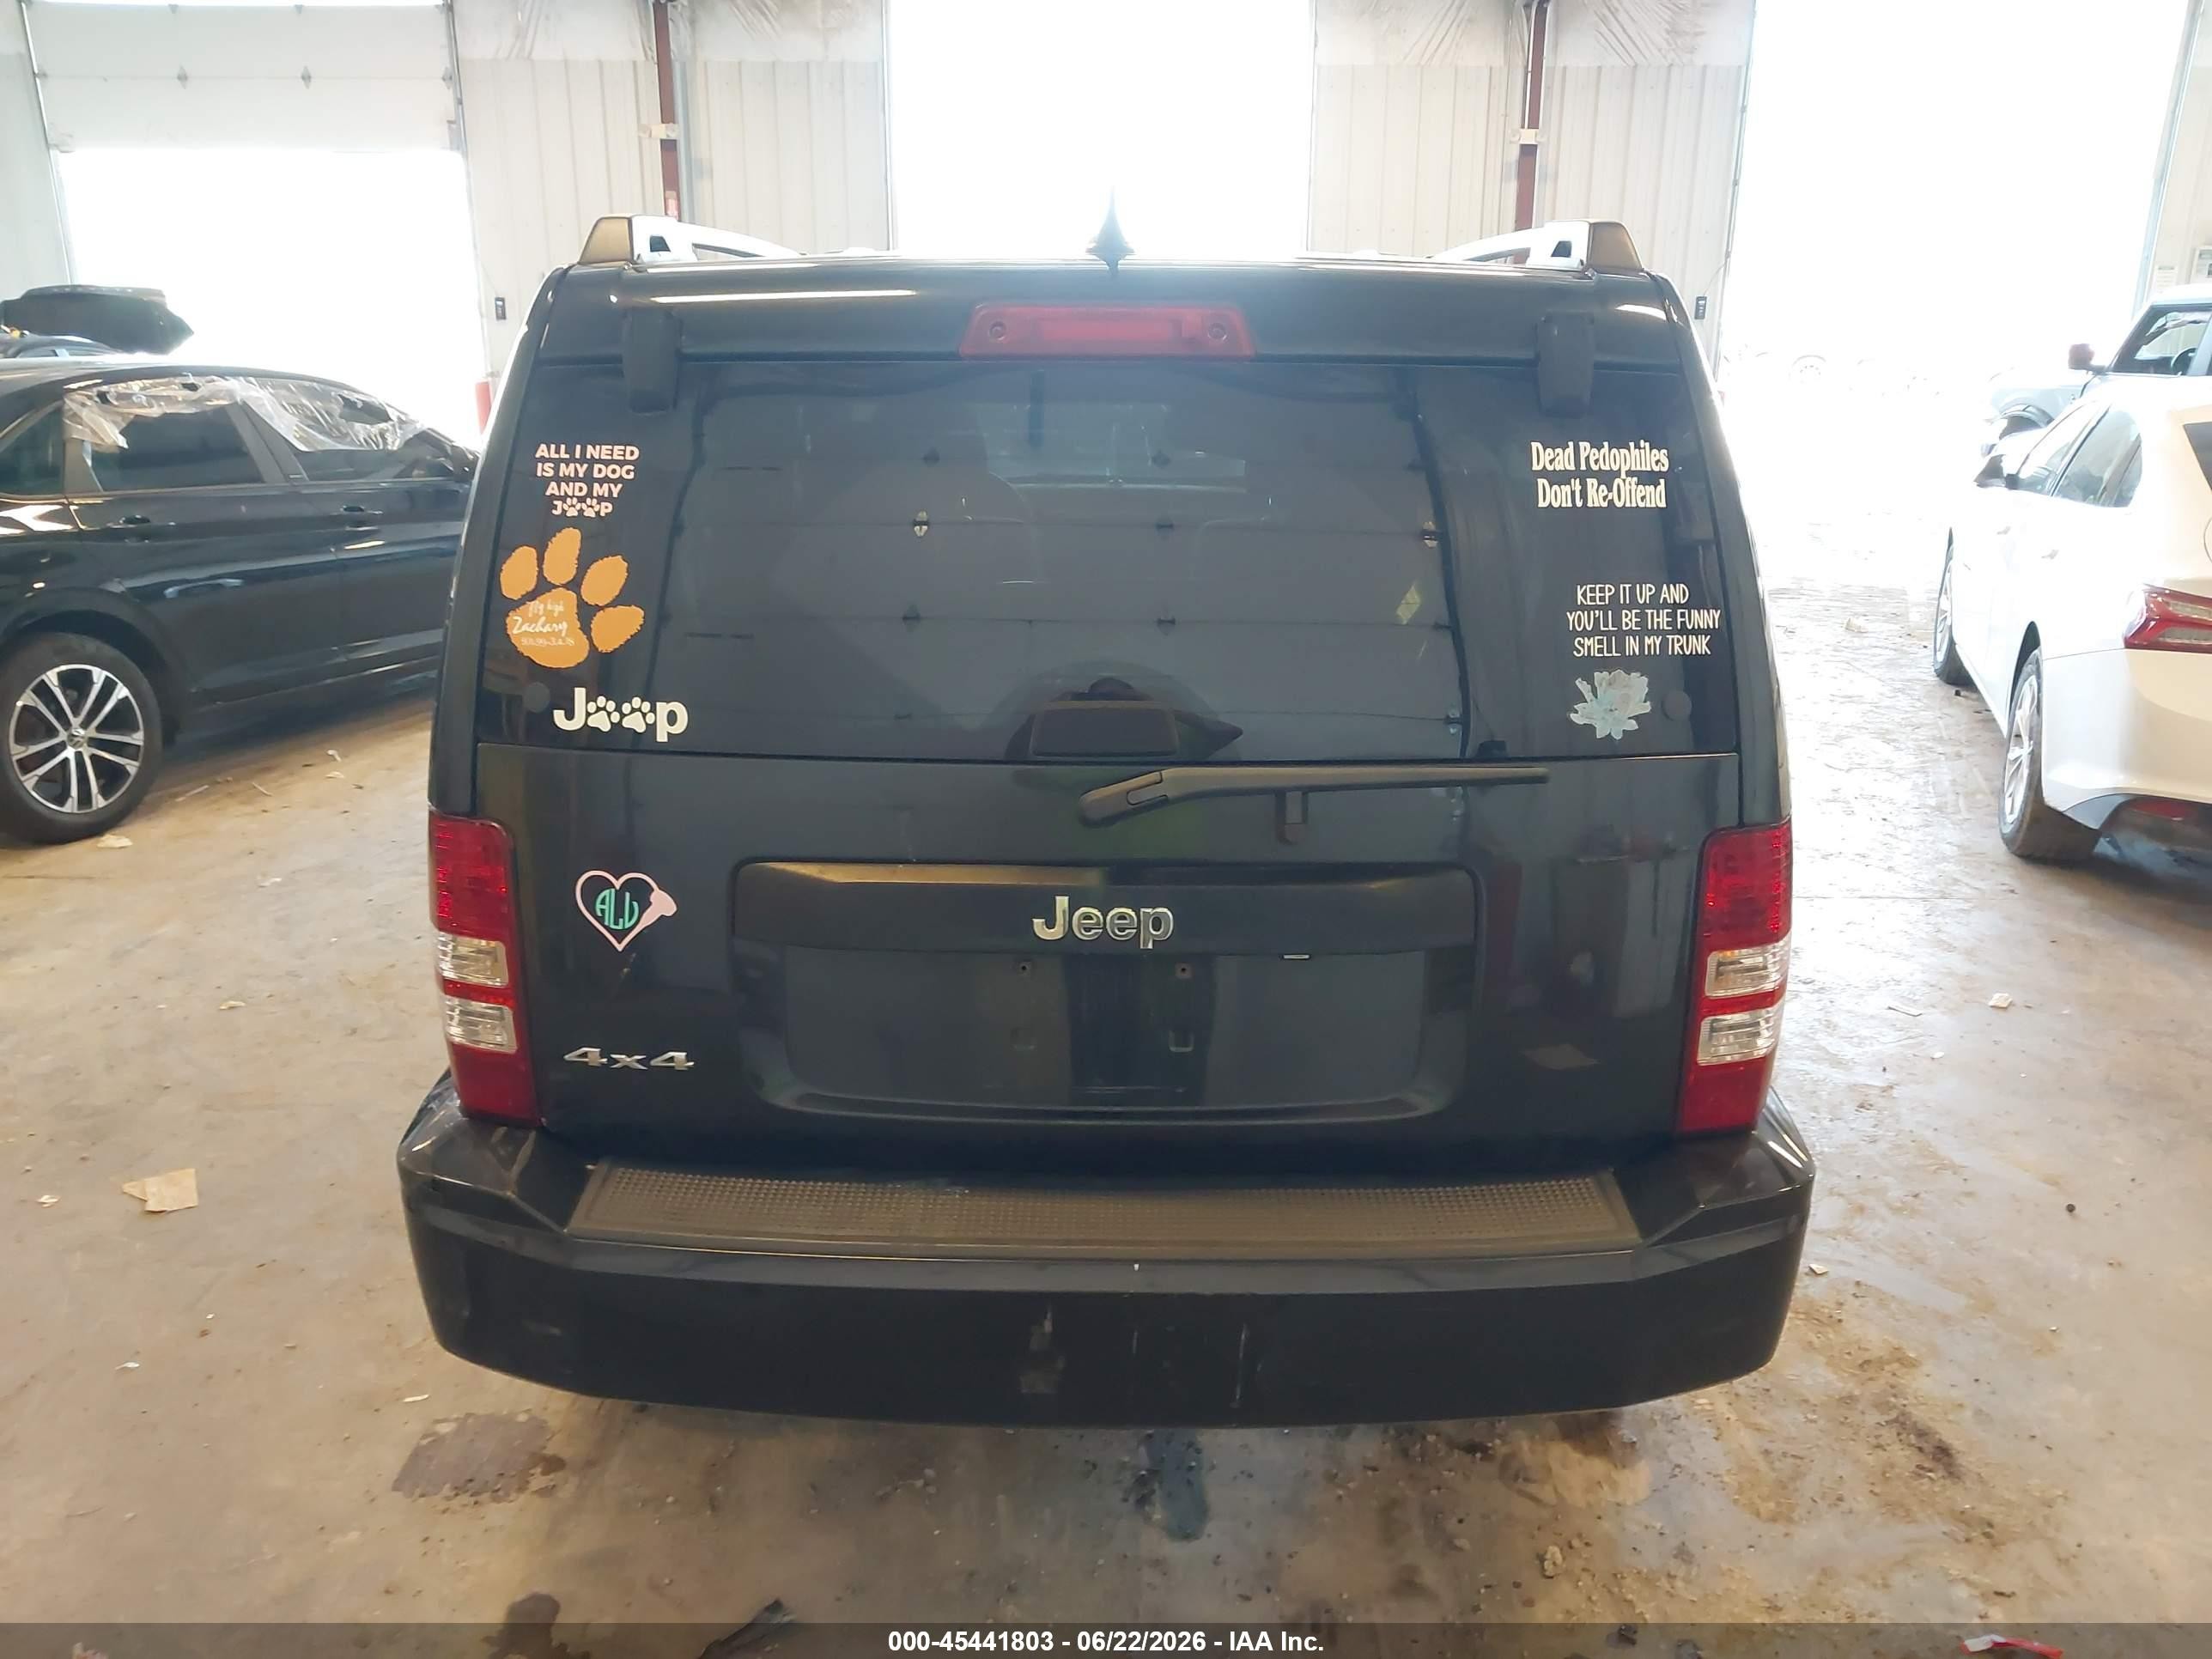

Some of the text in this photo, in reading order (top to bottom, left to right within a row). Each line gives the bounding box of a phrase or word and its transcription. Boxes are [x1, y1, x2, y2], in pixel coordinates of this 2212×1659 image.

[534, 443, 640, 461] ALL I NEED
[1530, 439, 1669, 479] Dead Pedophiles
[536, 462, 635, 480] IS MY DOG
[544, 481, 623, 498] AND MY
[1536, 477, 1667, 508] Don't Re-Offend
[1577, 583, 1689, 605] KEEP IT UP AND
[1566, 609, 1722, 632] YOU'LL BE THE FUNNY
[1572, 634, 1711, 657] SMELL IN MY TRUNK
[1033, 896, 1174, 949] Jeep
[562, 1047, 695, 1071] 4x4
